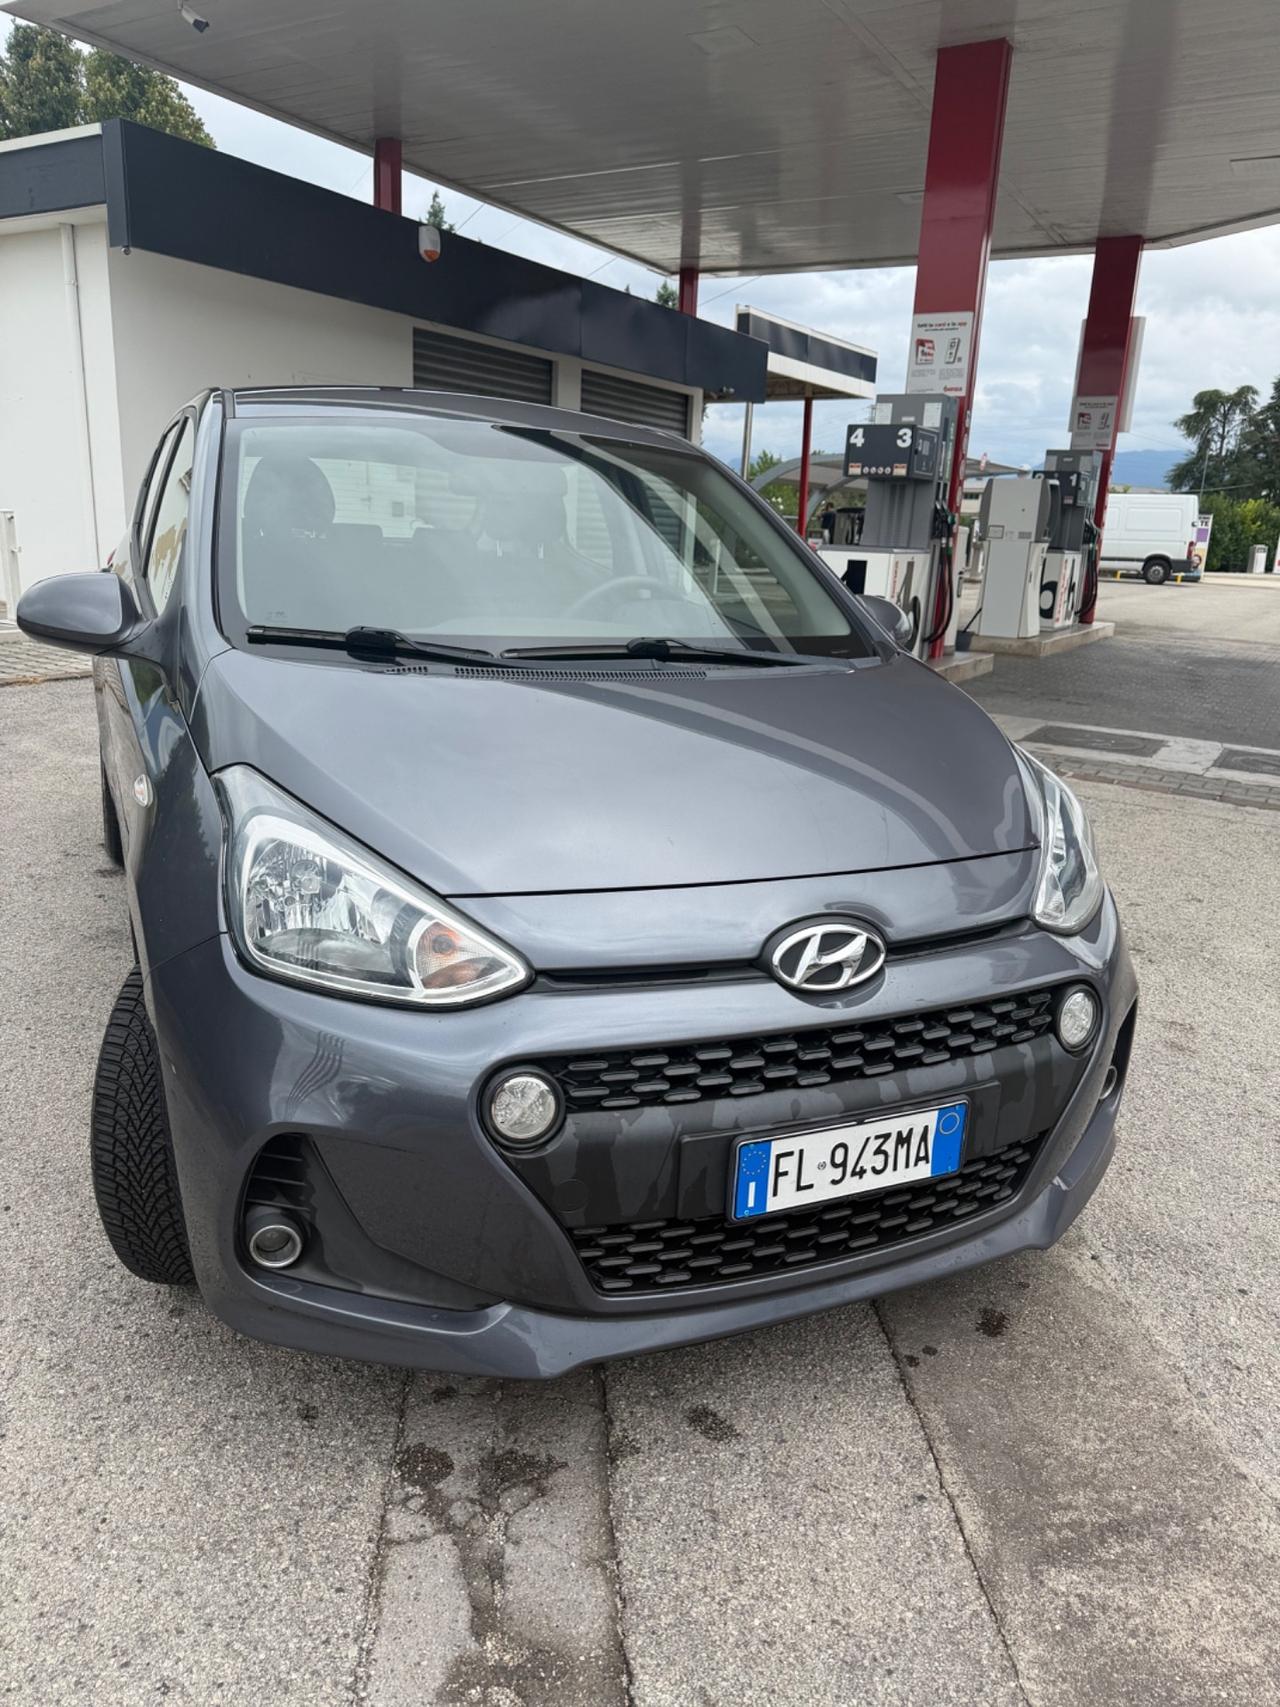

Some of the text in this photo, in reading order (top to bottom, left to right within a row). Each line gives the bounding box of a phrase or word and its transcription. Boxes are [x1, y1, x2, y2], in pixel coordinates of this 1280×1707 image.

[849, 428, 864, 447] 4
[896, 427, 912, 448] 3
[1069, 473, 1077, 487] 1
[772, 1124, 930, 1197] FL 943MA
